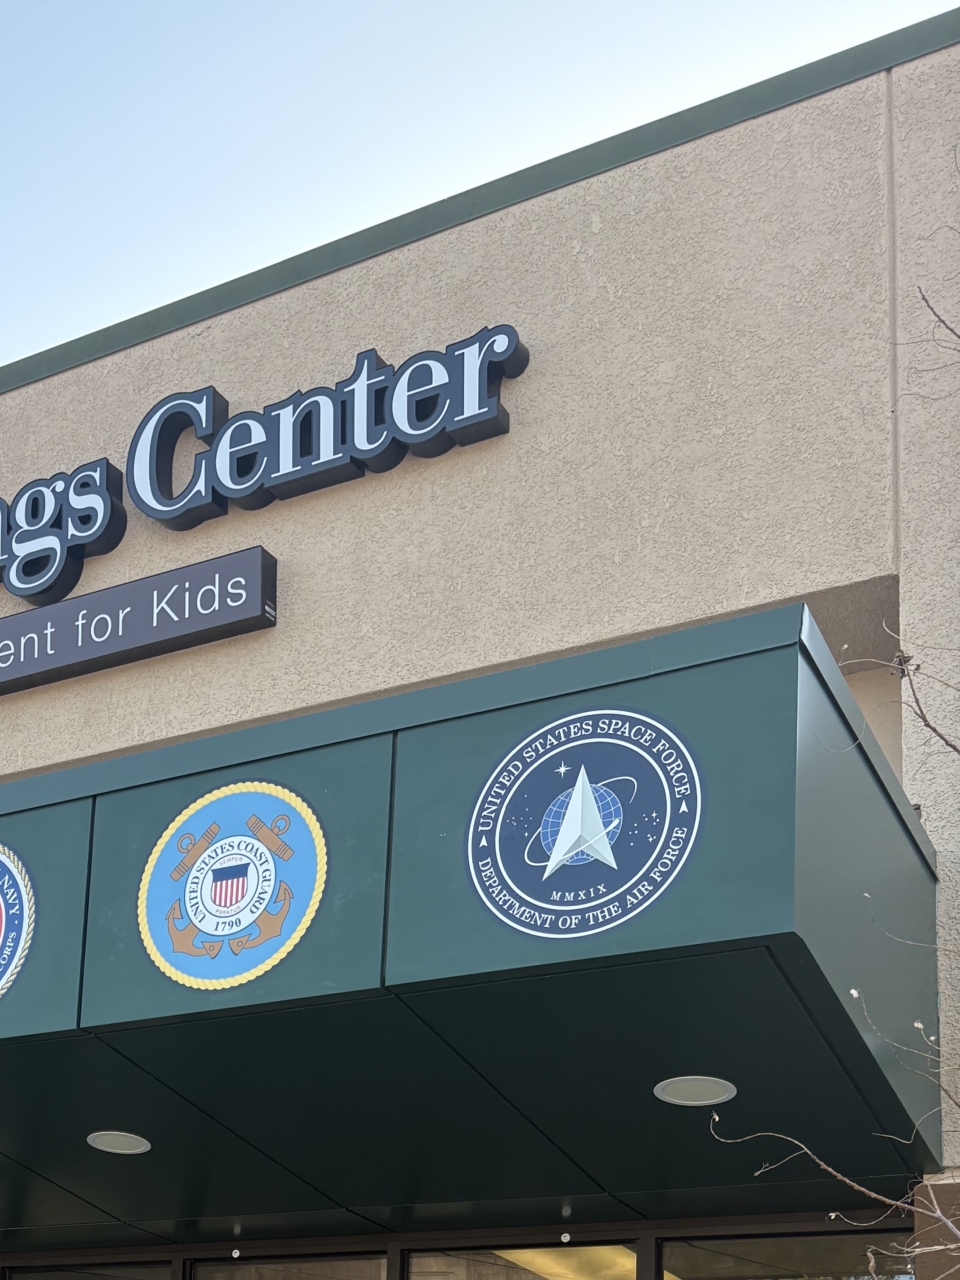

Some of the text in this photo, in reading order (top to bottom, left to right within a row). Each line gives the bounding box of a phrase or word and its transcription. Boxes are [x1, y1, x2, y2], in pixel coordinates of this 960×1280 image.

[131, 331, 511, 513] Center
[75, 606, 131, 647] for
[152, 573, 247, 627] Kids
[478, 718, 691, 832] UNITED STATES SPACE FORCE
[0, 874, 20, 915] NAVY
[189, 840, 271, 923] UNITED STATES COAST GUARD
[478, 827, 687, 929] DEPARTMENT OF THE AIR FORCE
[213, 917, 242, 932] 1790
